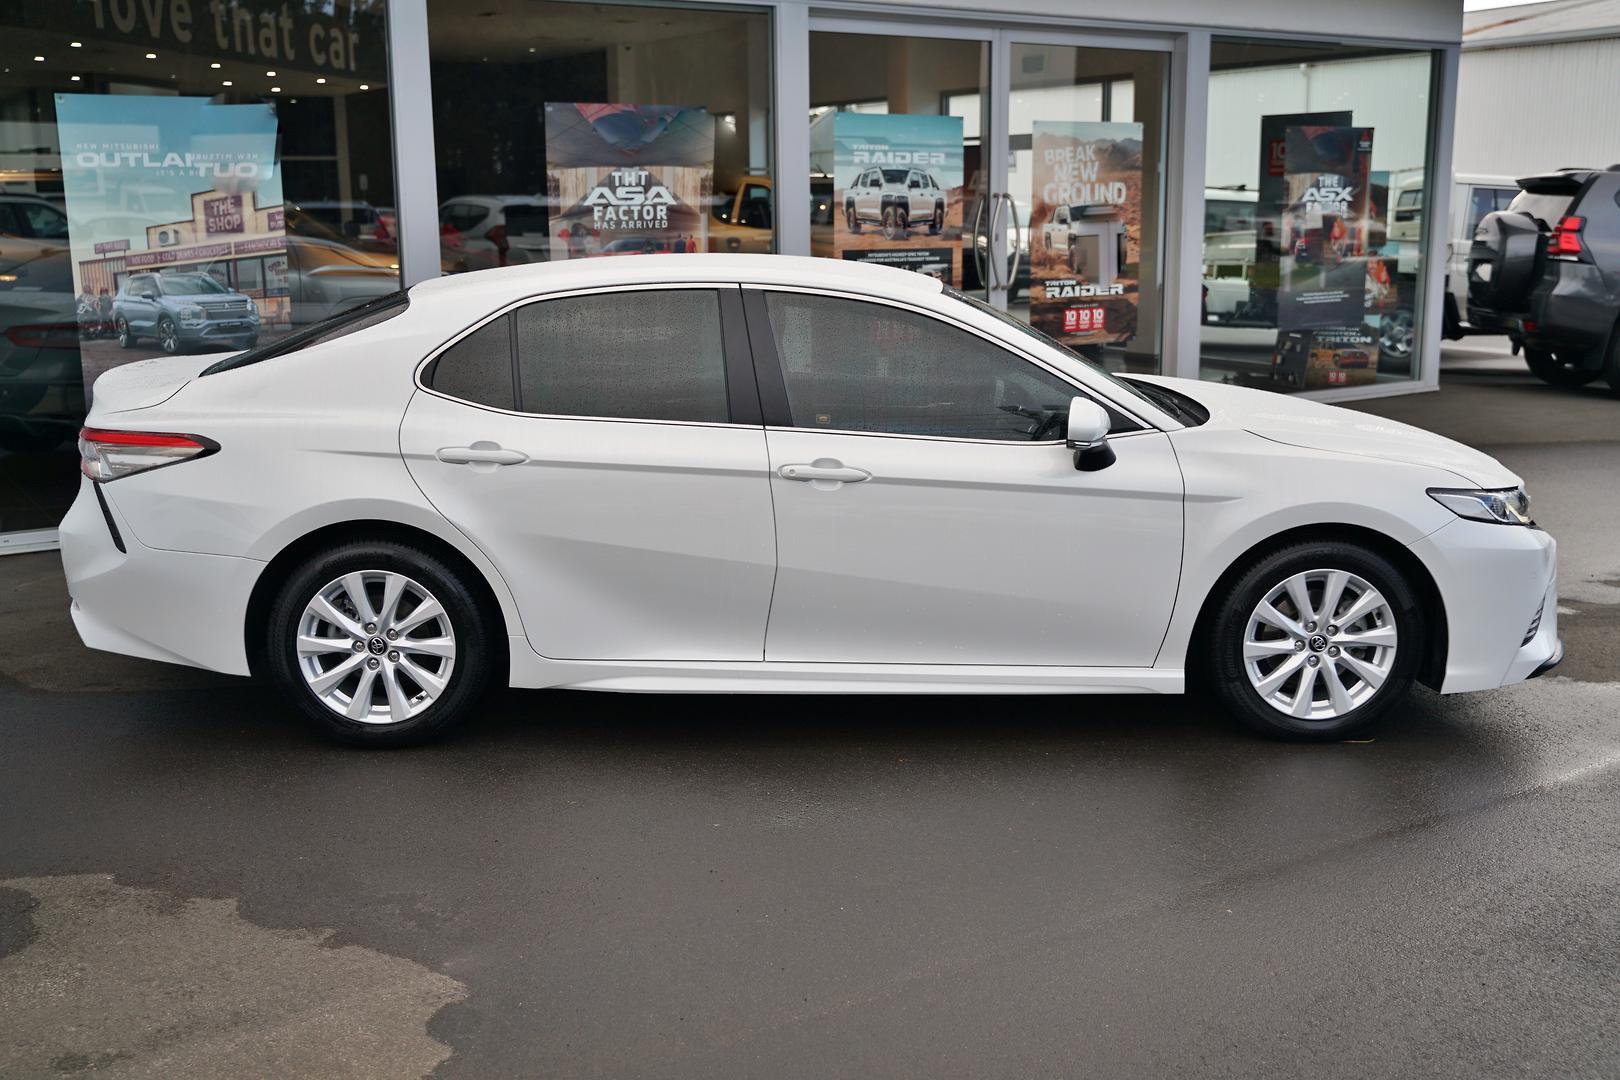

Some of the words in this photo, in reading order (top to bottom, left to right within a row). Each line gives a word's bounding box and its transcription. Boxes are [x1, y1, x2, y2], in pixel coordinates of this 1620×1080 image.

[210, 0, 295, 61] that
[309, 22, 359, 71] car
[853, 151, 945, 164] RAIDER
[1043, 144, 1096, 166] BREAK
[1055, 161, 1100, 182] NEW
[1318, 175, 1339, 187] THE
[1043, 181, 1127, 205] GROUND
[1302, 187, 1353, 202] ASX
[211, 197, 236, 214] THE
[593, 205, 668, 221] FACTOR
[208, 213, 242, 233] SHOP
[593, 220, 616, 230] HAS
[620, 220, 669, 229] ARRIVED
[1065, 311, 1077, 322] 10
[1079, 310, 1090, 321] 10
[1092, 309, 1104, 321] 10
